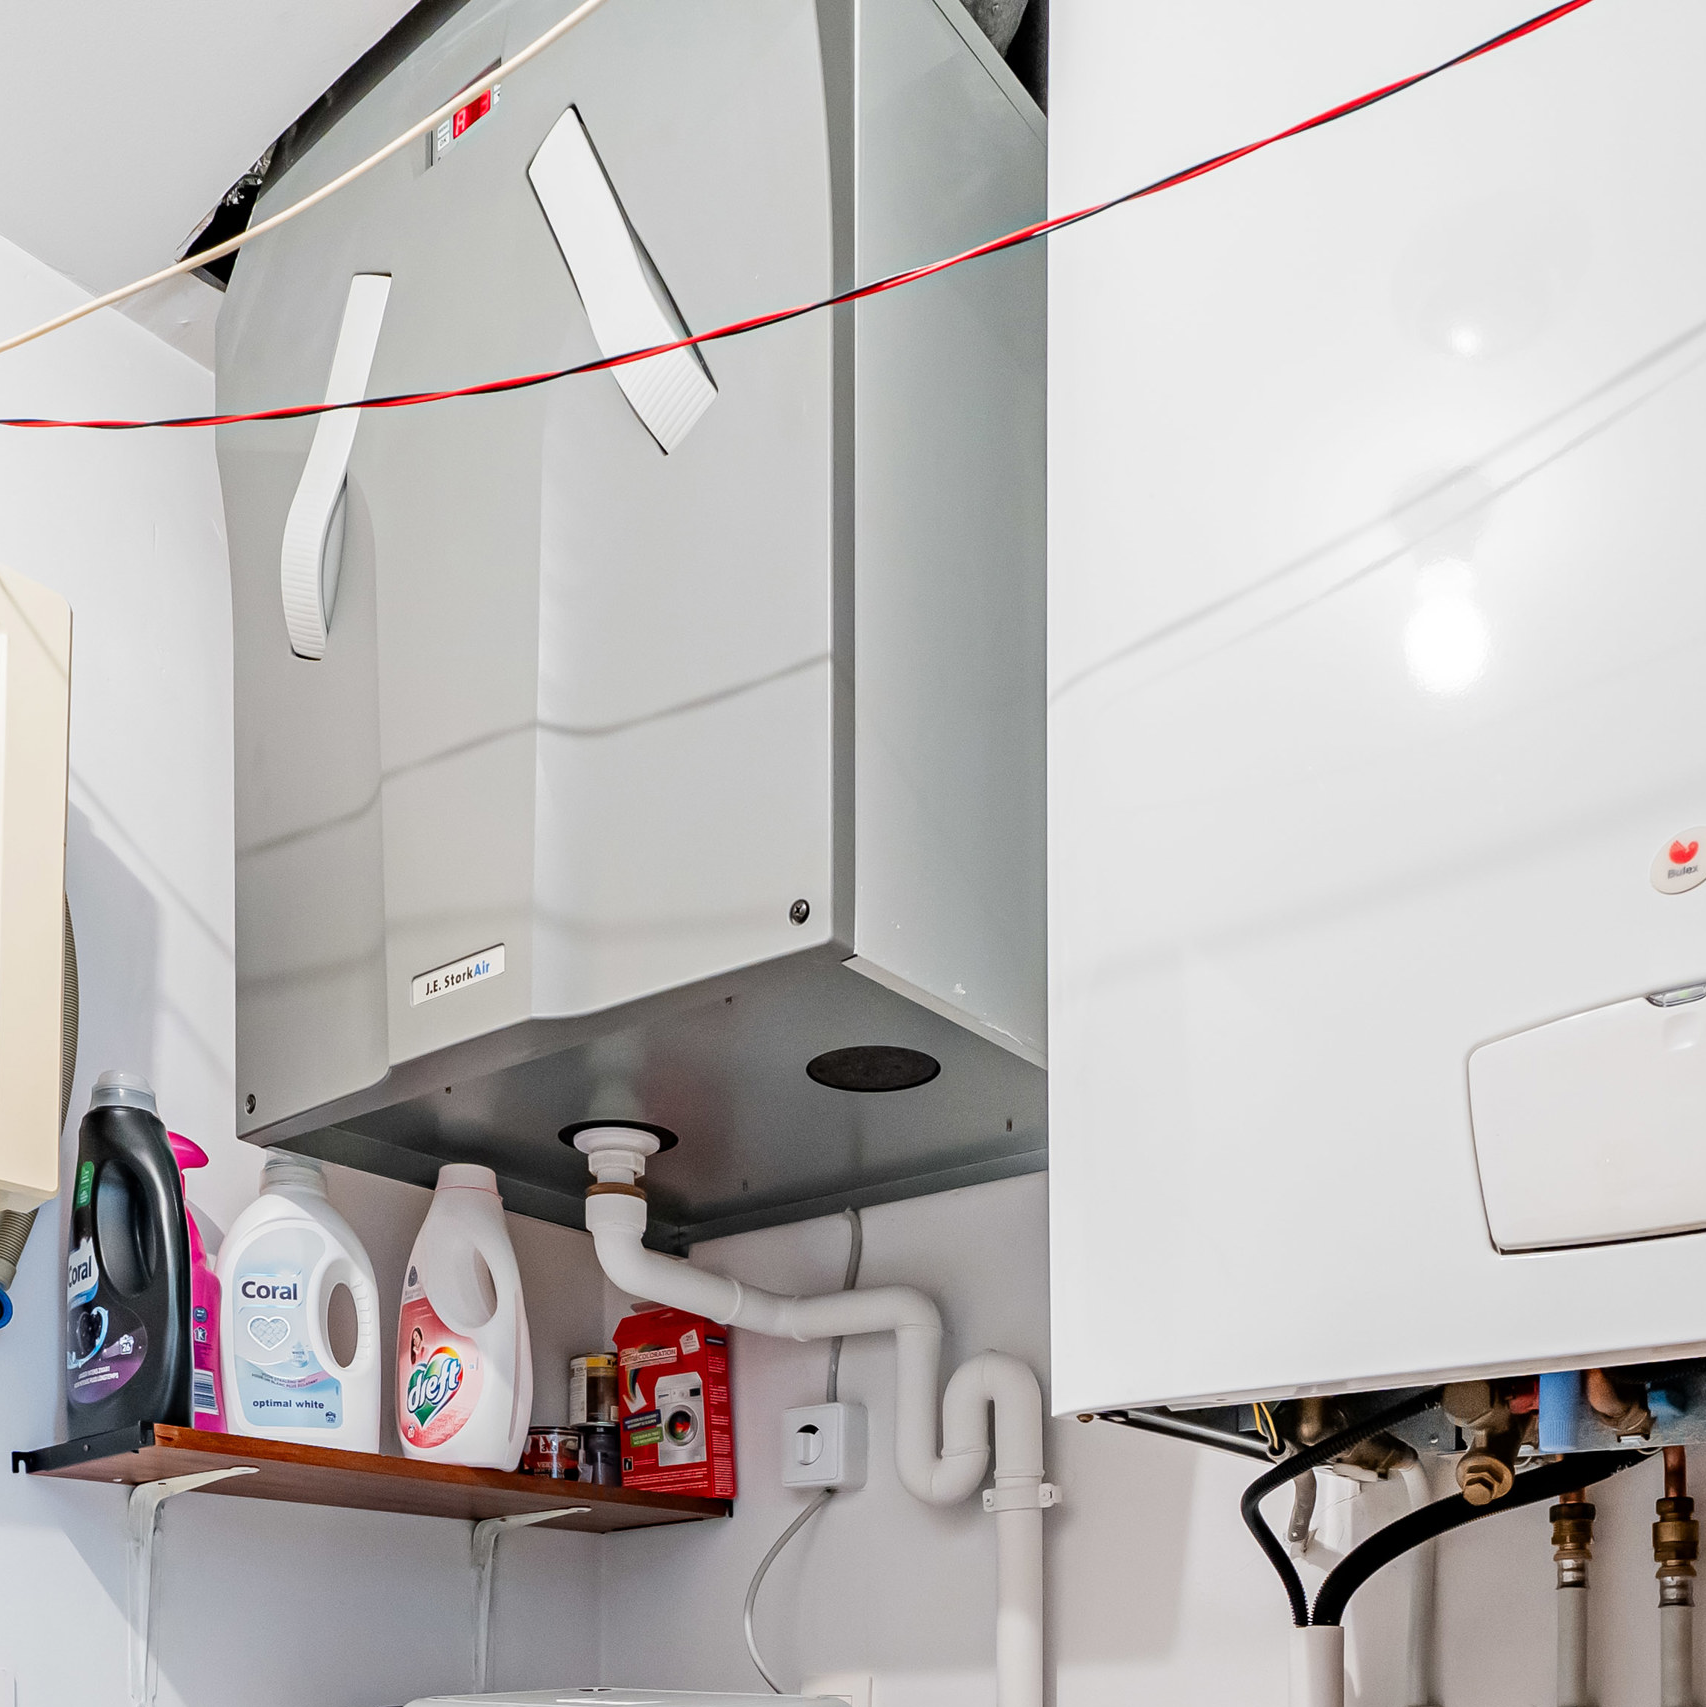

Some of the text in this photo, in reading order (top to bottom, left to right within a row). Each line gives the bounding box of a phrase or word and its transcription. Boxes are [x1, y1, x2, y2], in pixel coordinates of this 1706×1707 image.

[1667, 865, 1698, 879] Bulex
[426, 979, 442, 995] J.E.
[241, 1281, 298, 1300] Coral
[407, 1357, 461, 1414] dreft
[252, 1399, 325, 1409] optimal white
